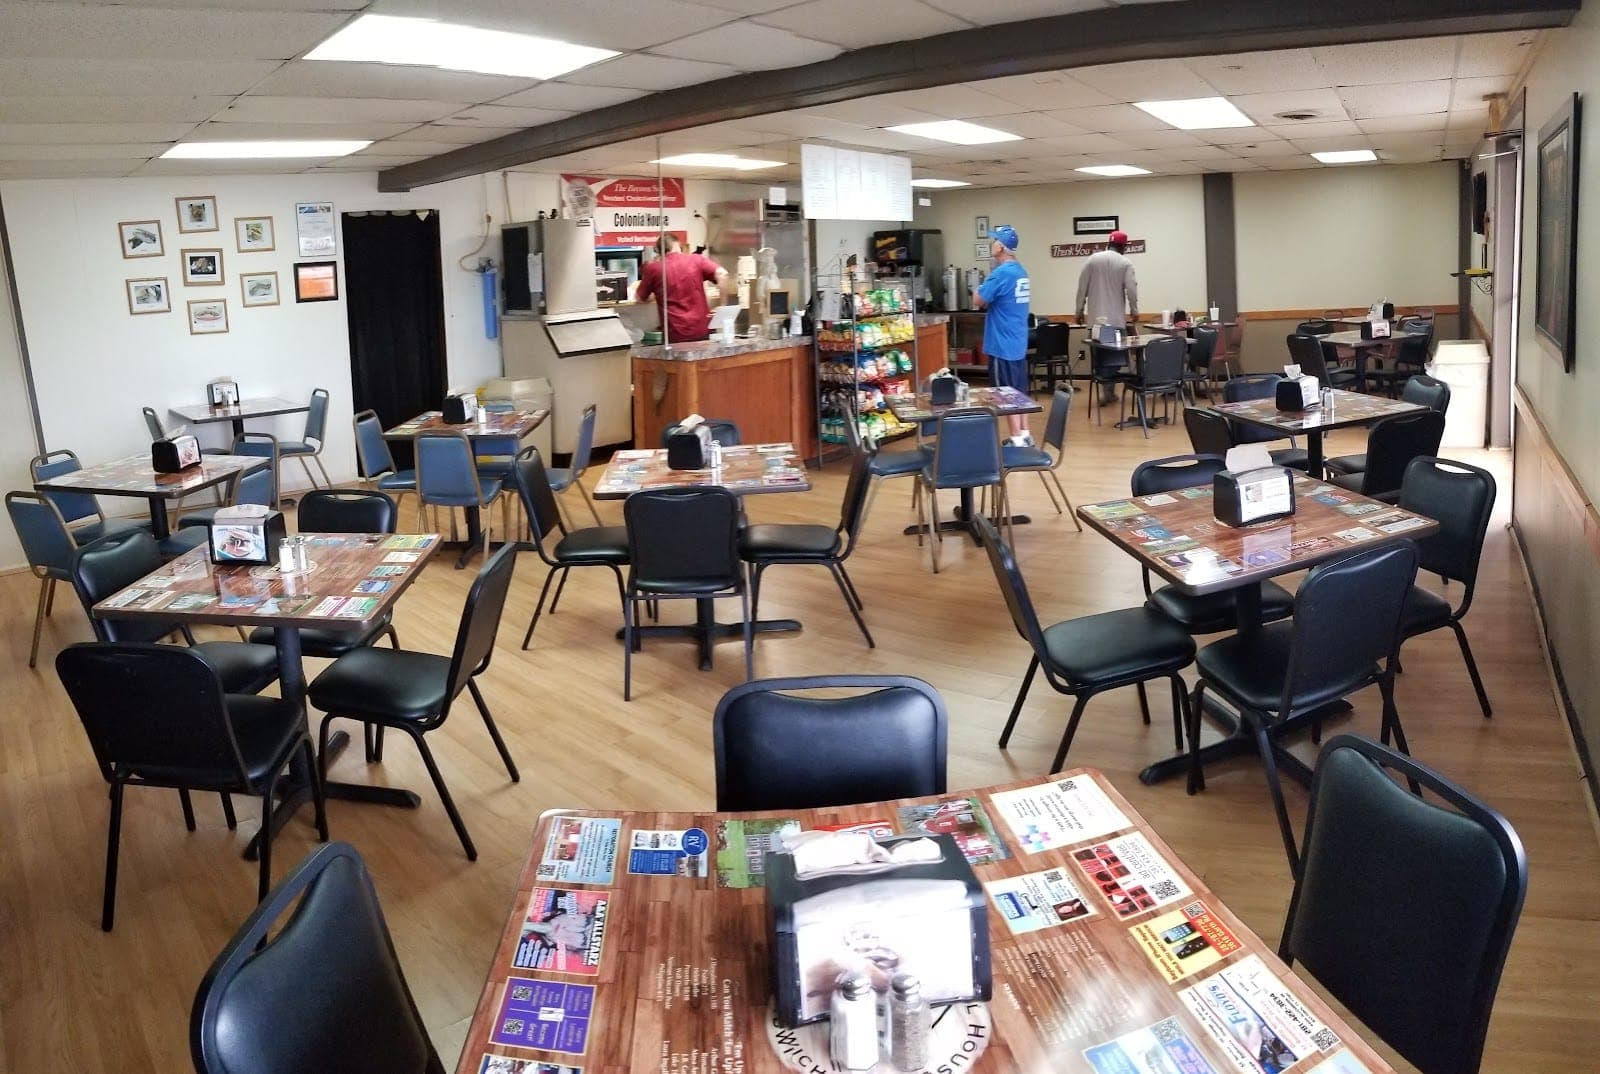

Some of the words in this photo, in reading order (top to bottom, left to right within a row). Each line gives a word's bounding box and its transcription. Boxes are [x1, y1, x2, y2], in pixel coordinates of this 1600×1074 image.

[647, 213, 670, 226] Houe
[1053, 246, 1074, 257] Thank
[1075, 243, 1090, 255] You
[688, 835, 700, 847] RV
[595, 900, 607, 918] A&A
[587, 920, 603, 965] ALLSTARZ
[723, 979, 731, 993] Can
[724, 1012, 733, 1037] Match
[926, 1023, 987, 1074] HOUS
